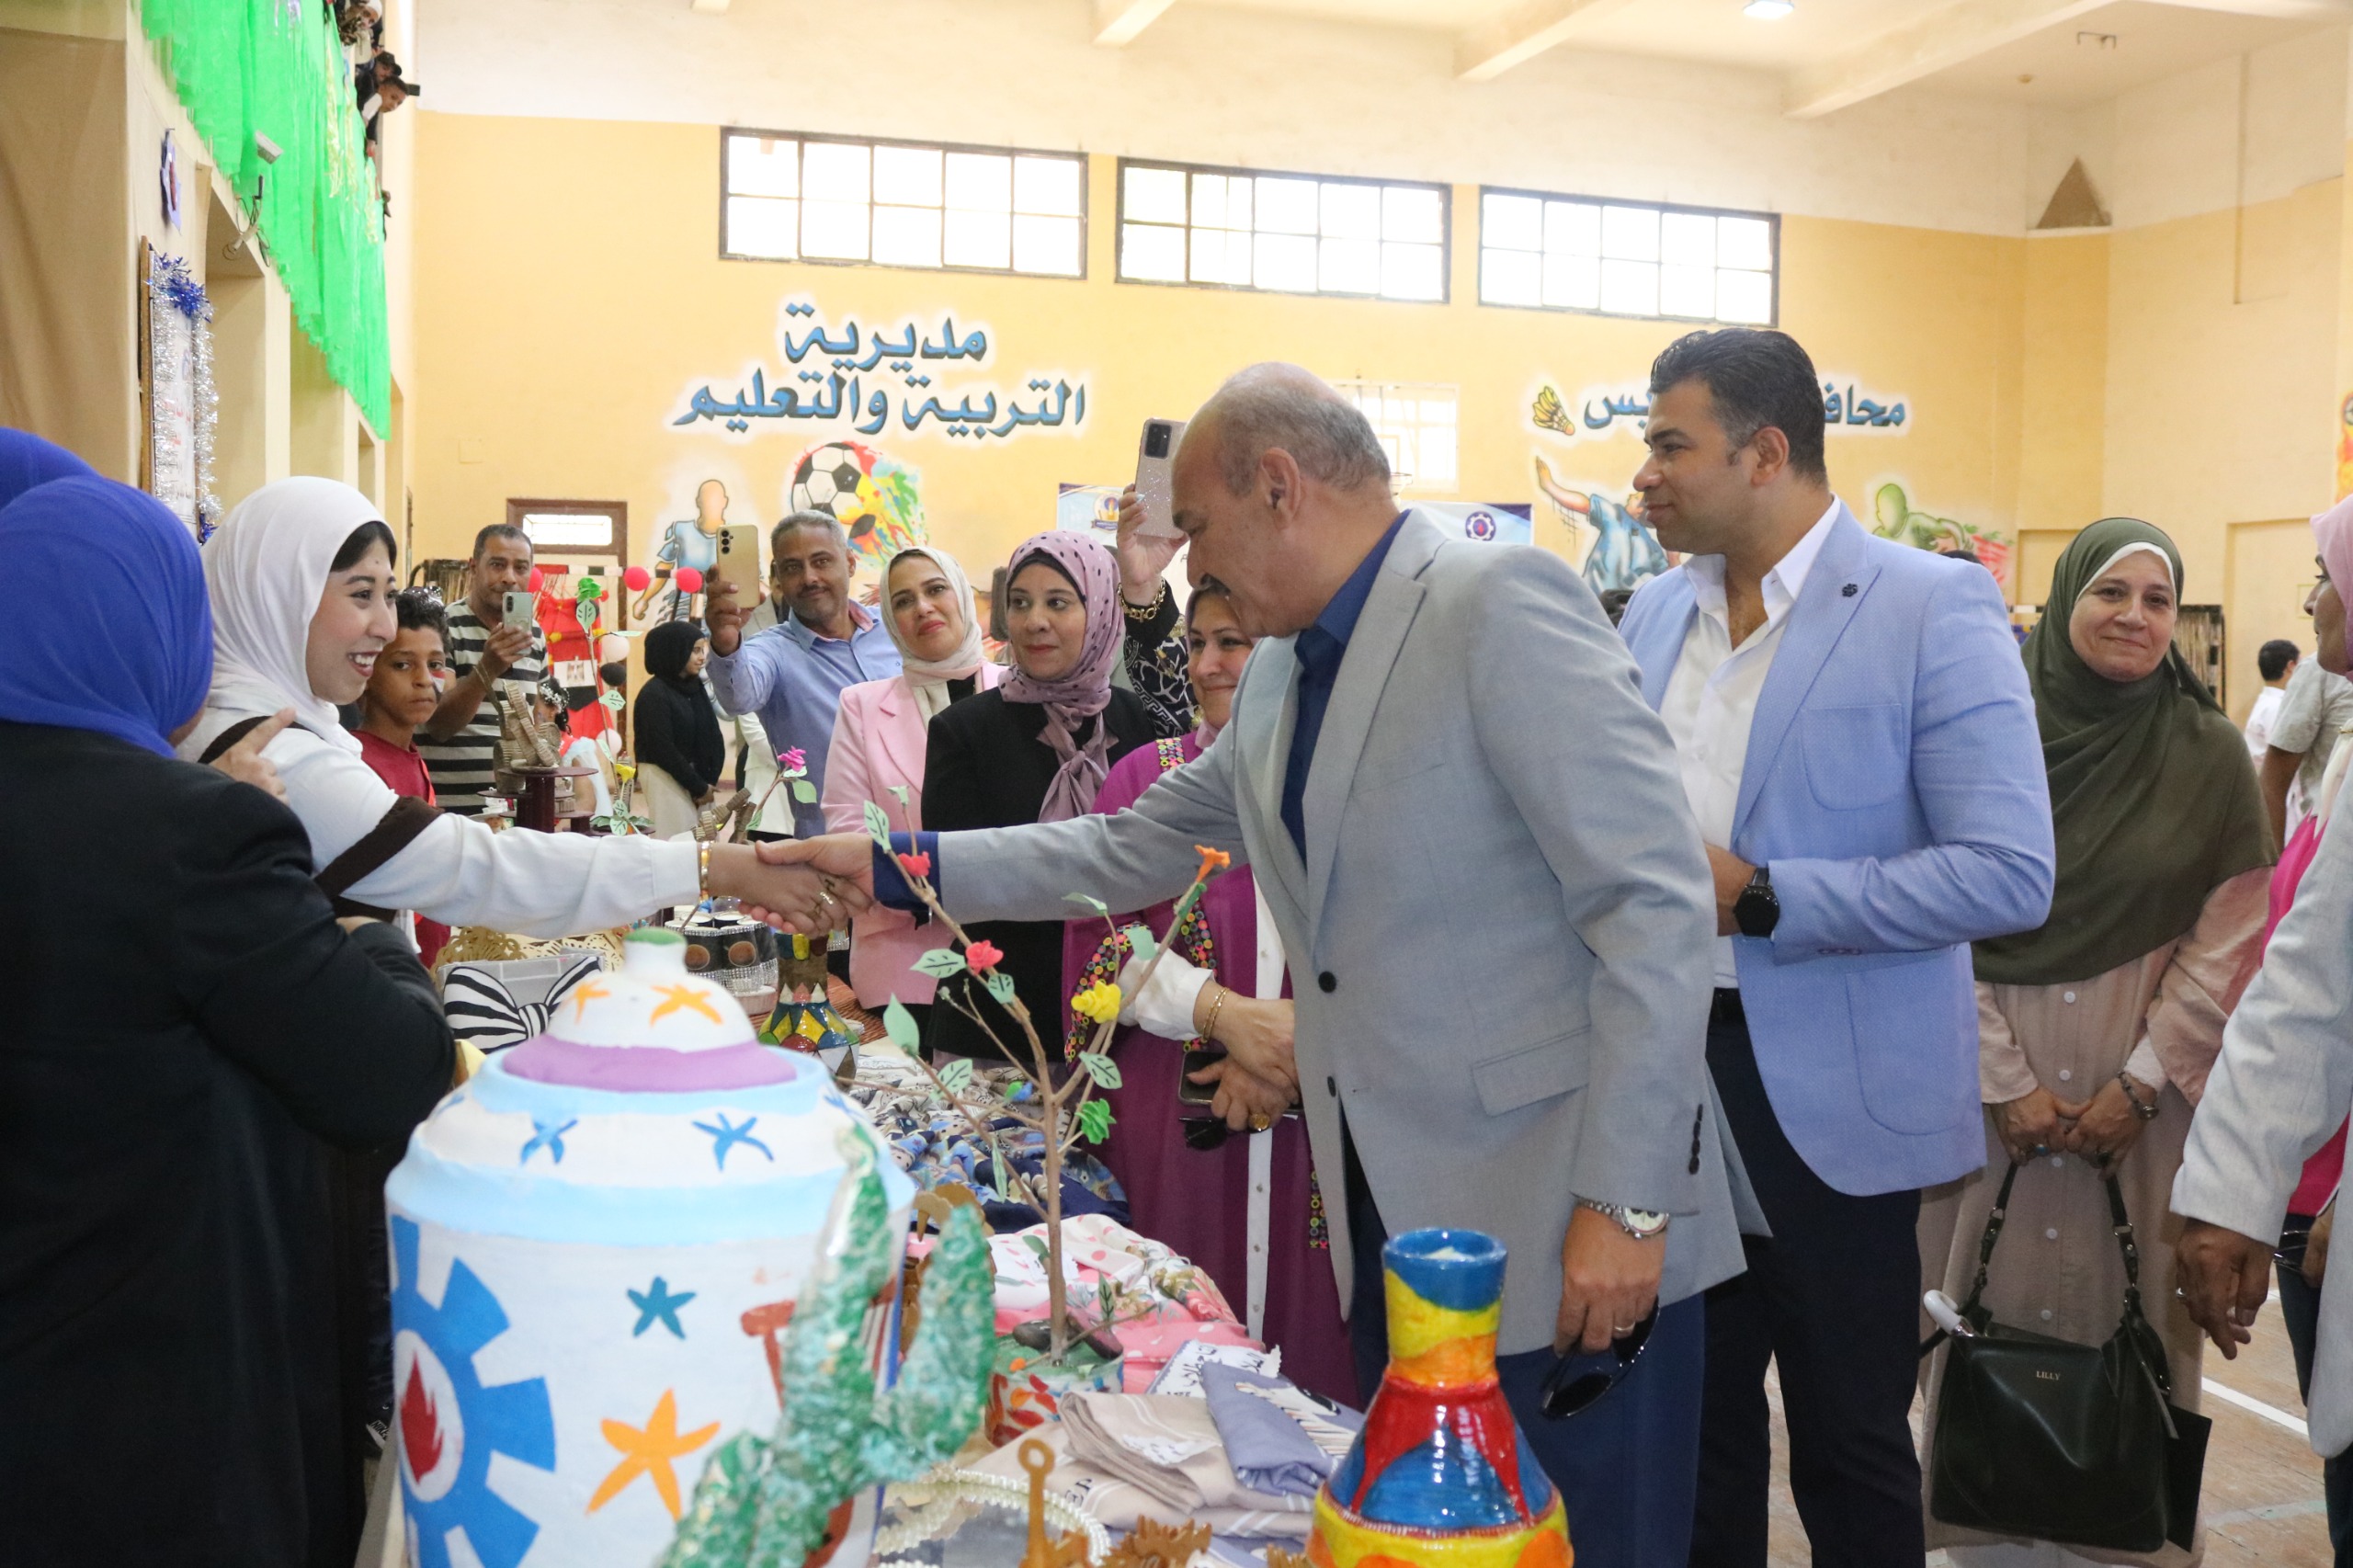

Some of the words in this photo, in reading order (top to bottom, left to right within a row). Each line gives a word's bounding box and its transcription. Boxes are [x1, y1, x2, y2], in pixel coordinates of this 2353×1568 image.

[784, 301, 987, 372] مديرية
[672, 367, 889, 436] والتعليم
[902, 372, 1086, 438] التربية
[1823, 382, 1906, 426] محاف
[2036, 1370, 2061, 1381] LILLY
